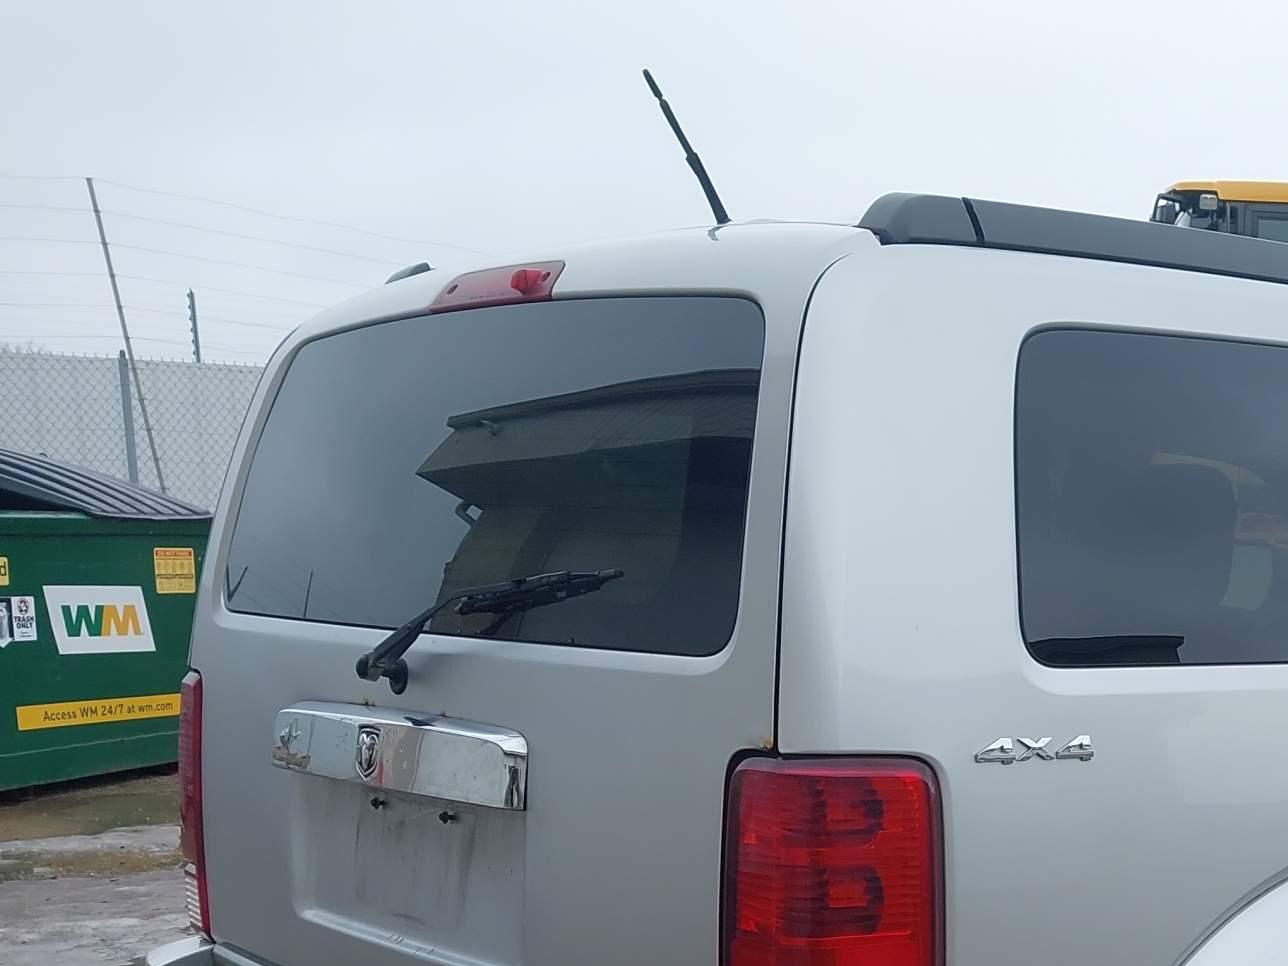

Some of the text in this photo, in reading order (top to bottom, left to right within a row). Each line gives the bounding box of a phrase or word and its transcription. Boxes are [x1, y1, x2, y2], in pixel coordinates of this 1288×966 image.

[60, 604, 142, 638] WM
[43, 702, 173, 722] Access WM 24/7 at wm.com
